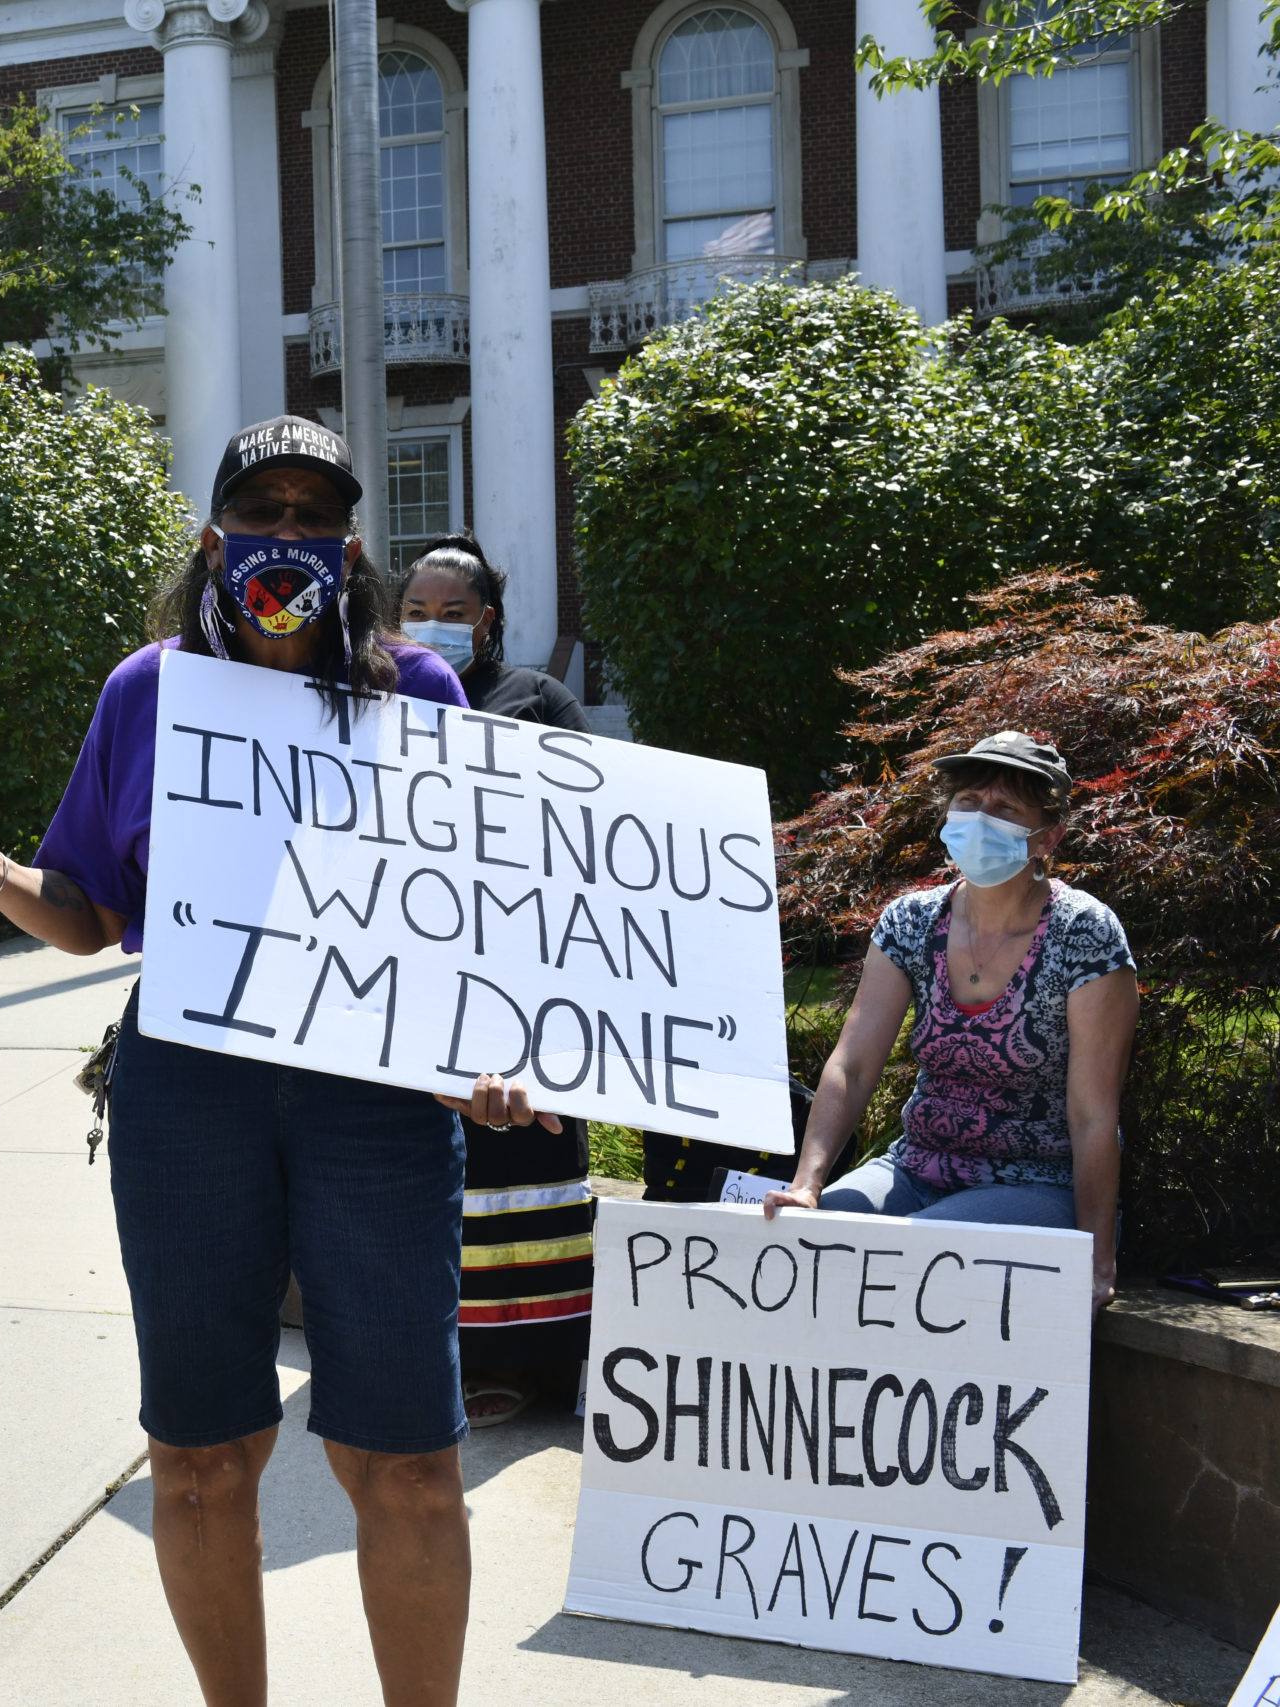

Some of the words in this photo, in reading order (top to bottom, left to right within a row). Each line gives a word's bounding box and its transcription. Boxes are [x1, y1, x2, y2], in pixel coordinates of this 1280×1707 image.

[238, 427, 274, 453] MAKE
[281, 424, 339, 456] AMERICA
[241, 440, 290, 469] NATIVE
[299, 441, 337, 464] AGAIN
[271, 548, 281, 559] &
[287, 548, 335, 587] MURDER
[304, 682, 606, 793] THIS
[167, 724, 773, 913] INDIGENOUS
[285, 840, 678, 987] WOMAN
[436, 971, 737, 1119] DONE"
[626, 1231, 1061, 1341] PROTECT
[592, 1347, 1064, 1530] SHINNECOCK
[641, 1512, 1029, 1636] GRAVES!
